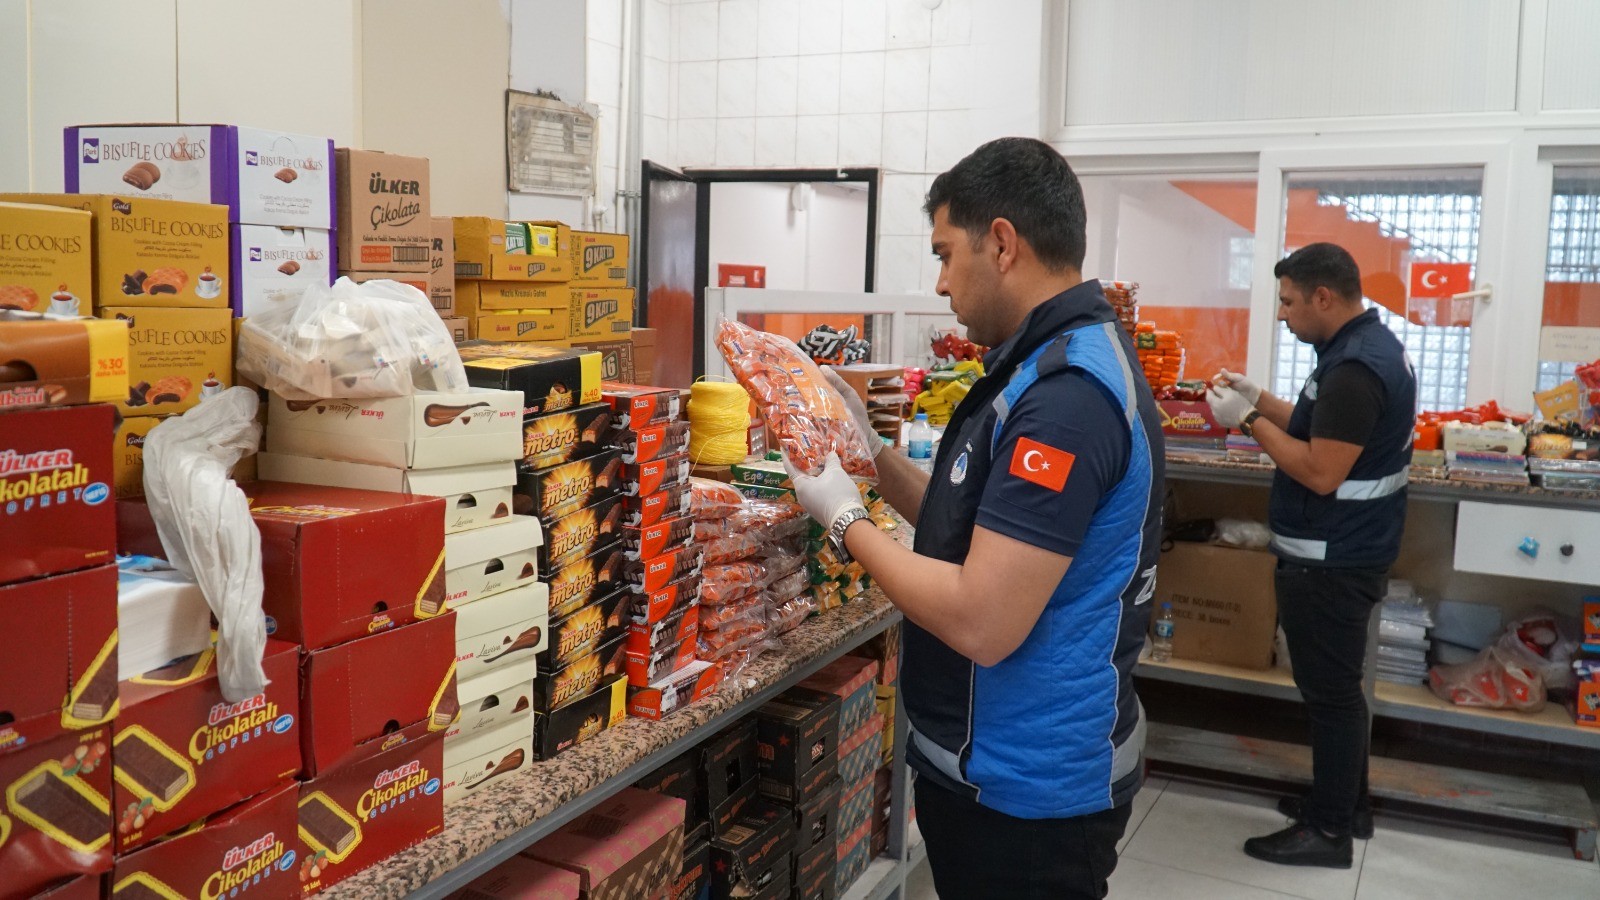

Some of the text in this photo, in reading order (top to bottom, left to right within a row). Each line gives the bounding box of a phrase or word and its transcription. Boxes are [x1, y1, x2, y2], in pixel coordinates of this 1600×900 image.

[103, 139, 206, 162] BISUFLE COOKIES
[260, 156, 323, 171] BISUFLE COOKIES
[369, 172, 420, 196] ÜLKER
[112, 202, 130, 211] Gold
[370, 197, 421, 231] Çikolata
[111, 217, 224, 239] BISUFLE COOKIES
[16, 233, 81, 254] COOKIES
[264, 250, 324, 260] BISUFLE COOKIES
[129, 329, 227, 346] SUFLE COOKIES
[360, 409, 384, 419] ÜLKER
[499, 410, 516, 418] ÜLKER
[545, 397, 571, 411] metro
[525, 428, 575, 456] metro
[0, 463, 89, 502] kolatalı
[545, 476, 590, 508] metro
[742, 471, 764, 484] Ege
[6, 487, 82, 516] OFRET
[553, 523, 595, 557] metro
[551, 572, 593, 607] metro
[560, 619, 602, 656] metro
[554, 667, 599, 704] metro
[208, 693, 265, 725] ÜLKER
[189, 702, 278, 765] Çikolatalı
[206, 721, 273, 760] GOFRET
[374, 760, 420, 789] ÜLKER
[357, 768, 428, 822] Çikolatalı
[370, 785, 424, 818] GOFRET
[222, 832, 274, 871] ÜLKER
